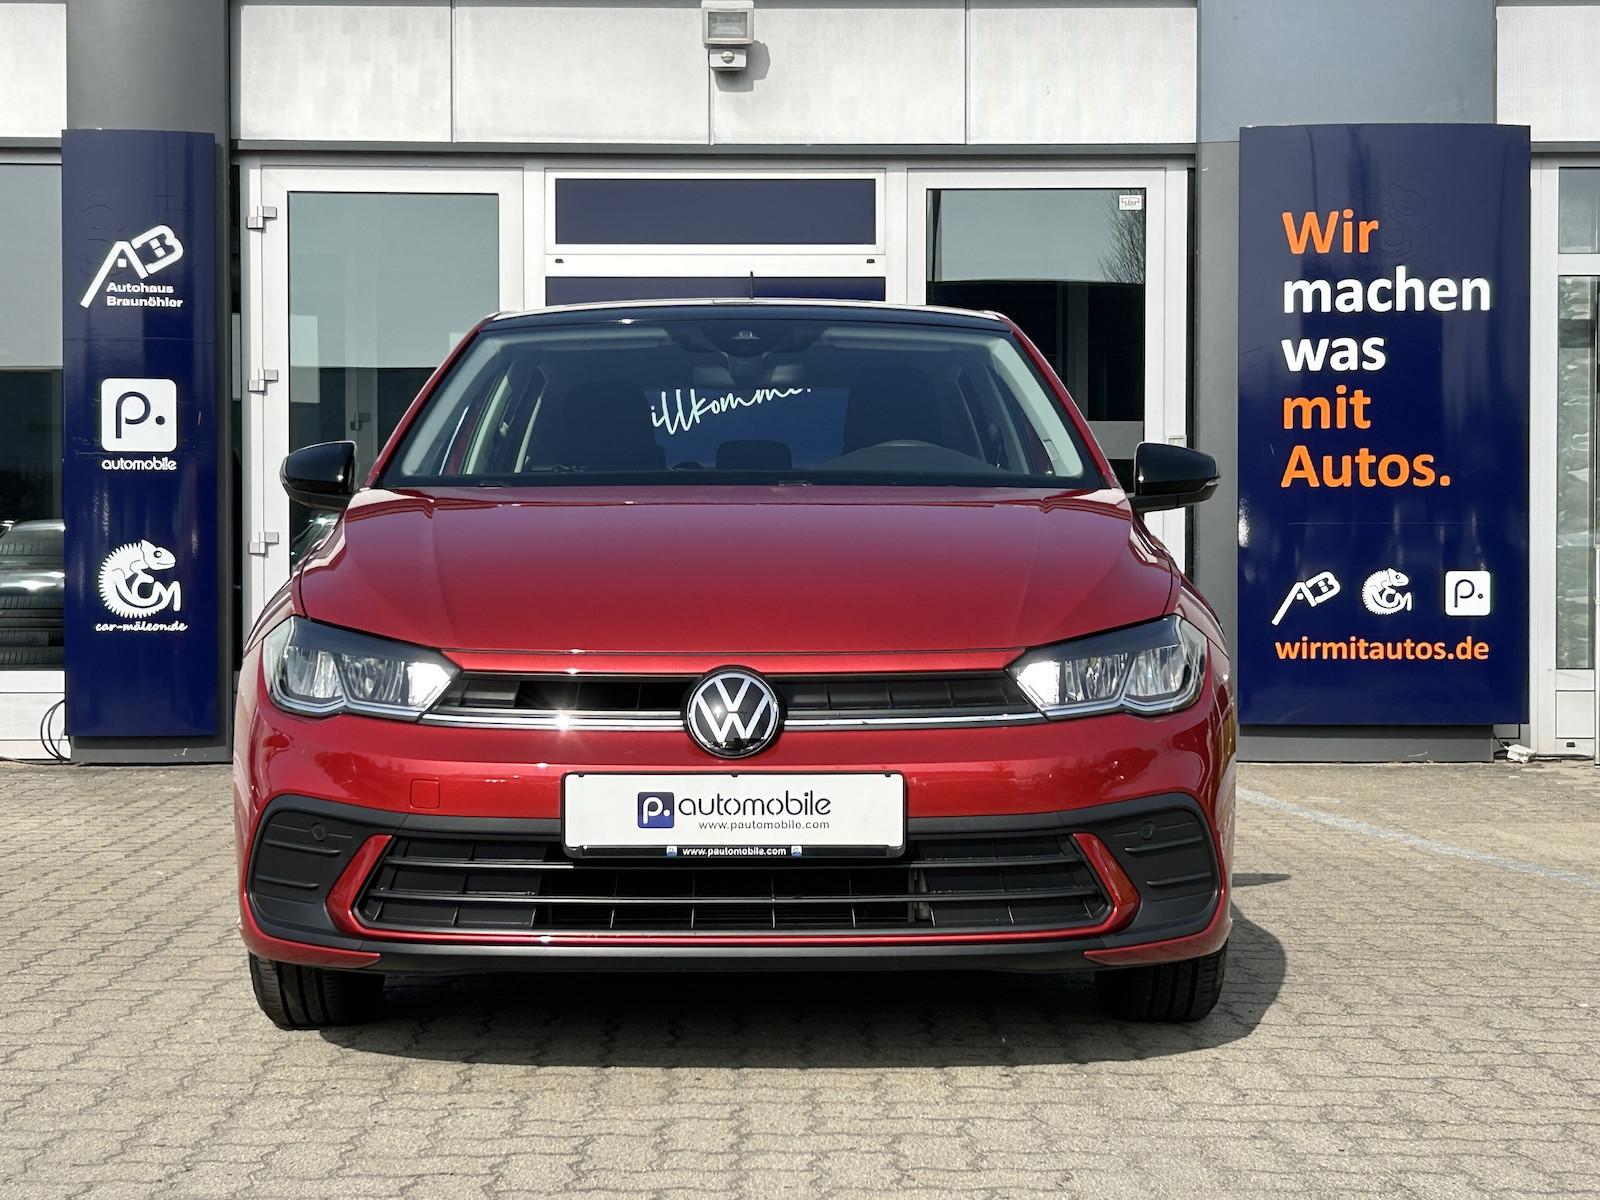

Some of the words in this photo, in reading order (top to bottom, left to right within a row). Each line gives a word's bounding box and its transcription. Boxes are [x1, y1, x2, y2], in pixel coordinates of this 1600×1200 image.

[1281, 208, 1379, 254] Wir
[106, 282, 174, 293] Autohaus
[1283, 265, 1491, 313] machen
[106, 295, 183, 308] Braunöhler
[1281, 336, 1386, 372] was
[1283, 384, 1371, 430] mit
[101, 456, 177, 471] automobile
[1280, 444, 1452, 488] Autos.
[1274, 635, 1490, 660] wirmitautos.de
[678, 790, 831, 816] automobile
[699, 820, 830, 832] www.pautomobile.com
[682, 846, 787, 858] www.pautomobile.com
